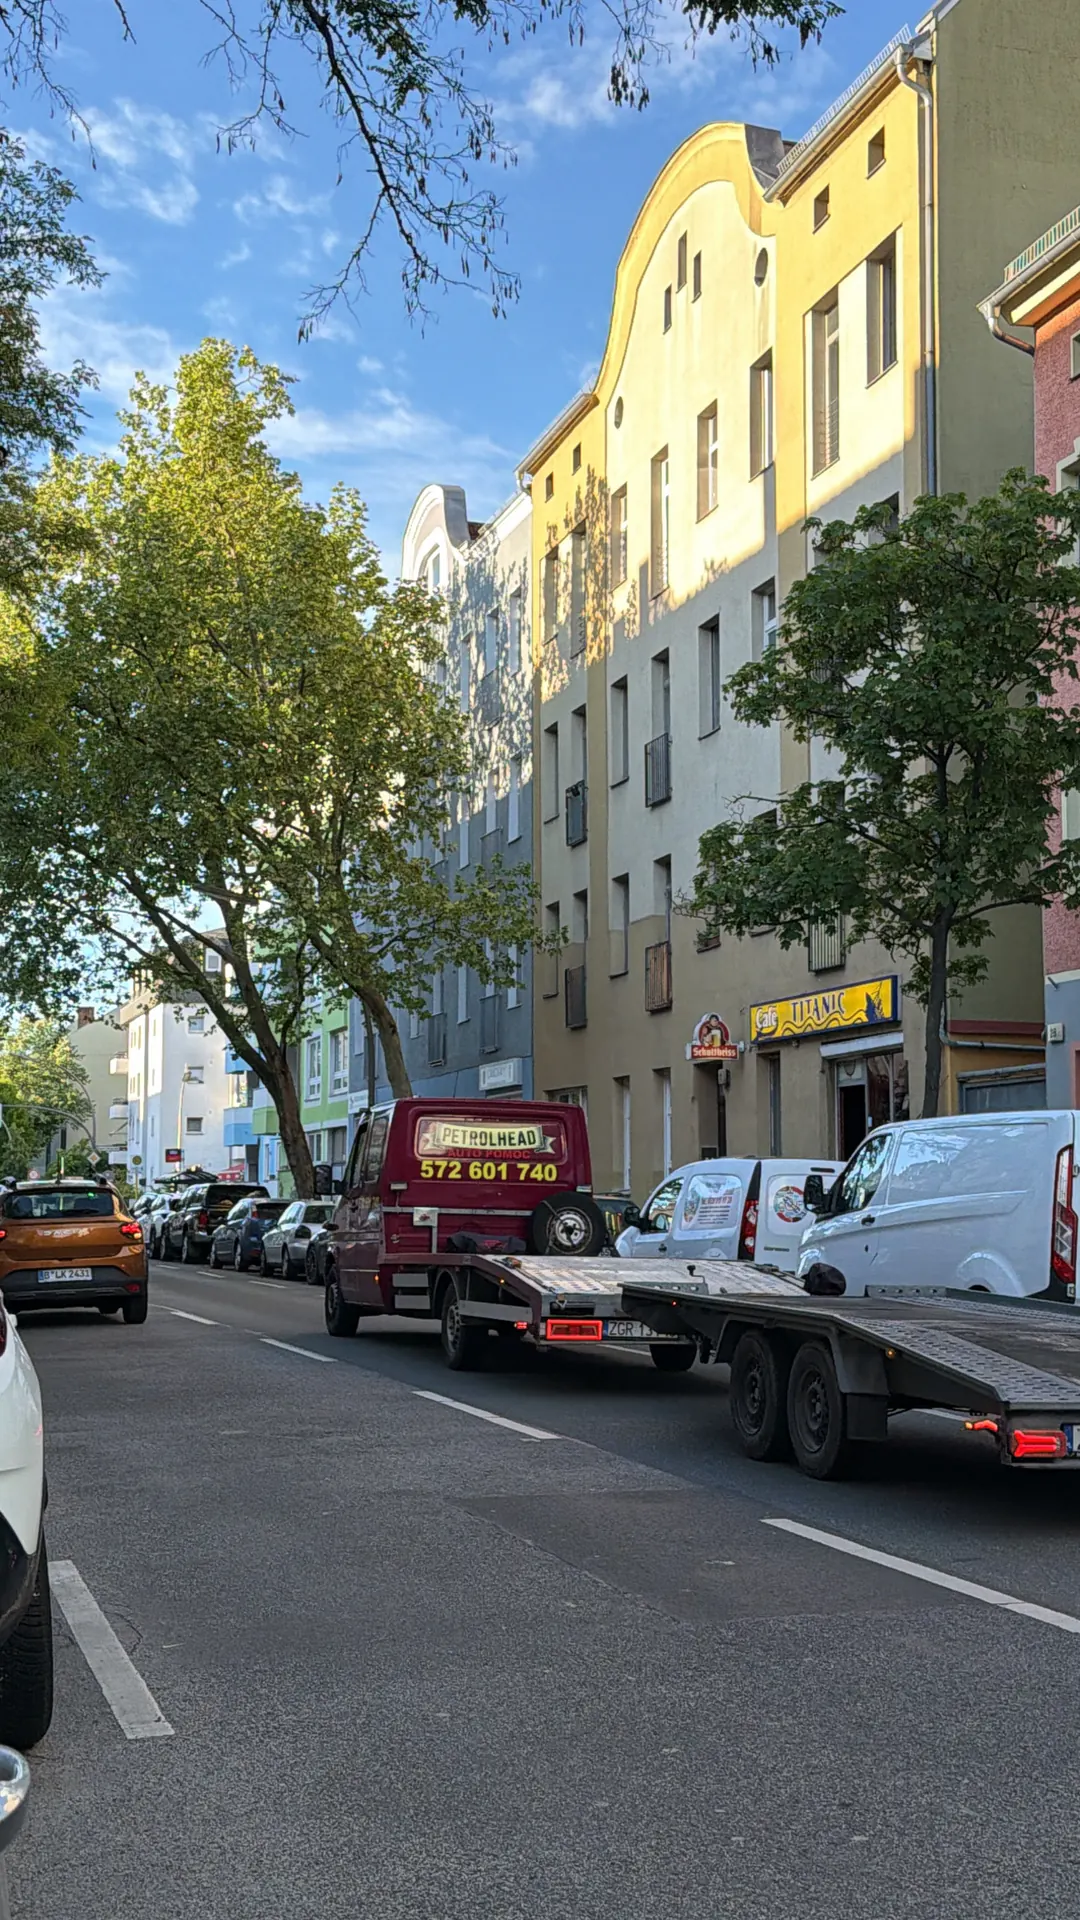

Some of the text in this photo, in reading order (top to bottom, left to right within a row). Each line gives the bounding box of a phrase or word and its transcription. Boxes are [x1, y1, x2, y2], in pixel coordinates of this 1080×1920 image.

[756, 992, 844, 1029] Café TITANIC
[442, 1127, 537, 1147] PETROLHEAD
[447, 1149, 531, 1159] AUTO POMOC
[420, 1160, 557, 1181] 572 601 740
[609, 1321, 634, 1336] ZGR
